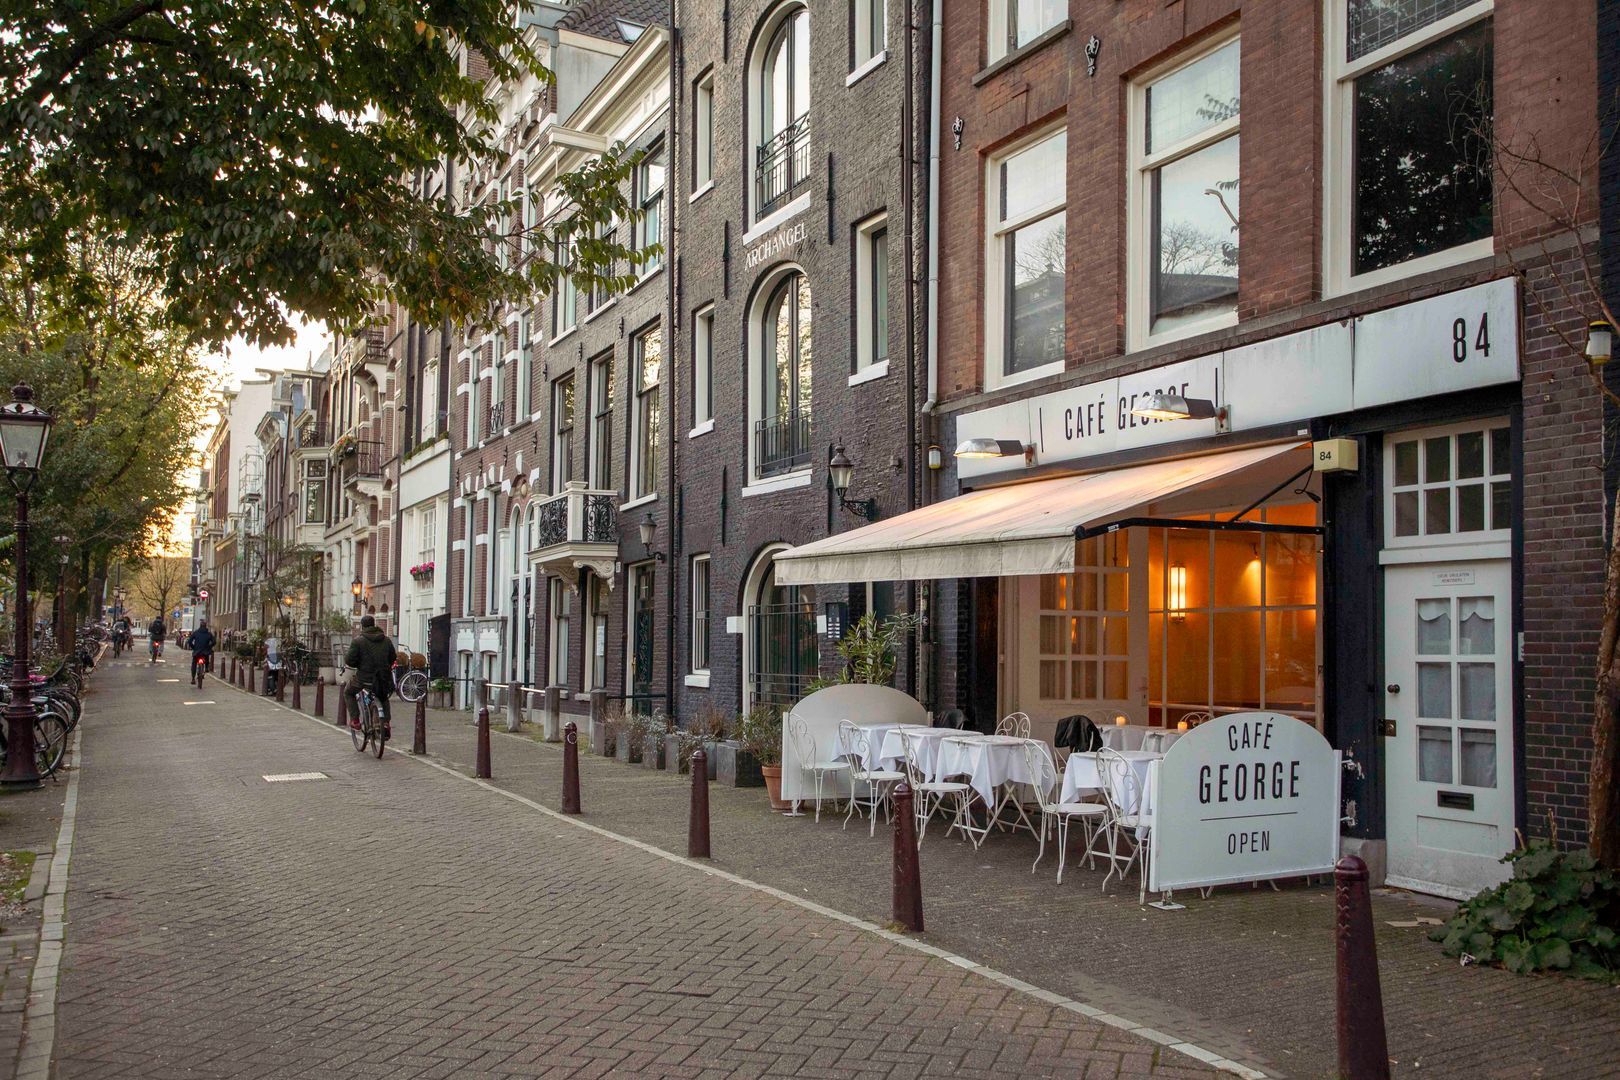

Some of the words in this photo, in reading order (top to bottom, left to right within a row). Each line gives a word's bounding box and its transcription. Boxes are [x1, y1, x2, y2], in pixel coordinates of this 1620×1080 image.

[744, 222, 808, 271] ARCHANGEL
[1453, 311, 1491, 364] 84
[1064, 393, 1105, 441] CAFÉ
[1319, 451, 1332, 461] 84
[1227, 717, 1275, 752] CAFÉ
[1199, 760, 1300, 805] GEORGE
[1227, 830, 1270, 855] OPEN
